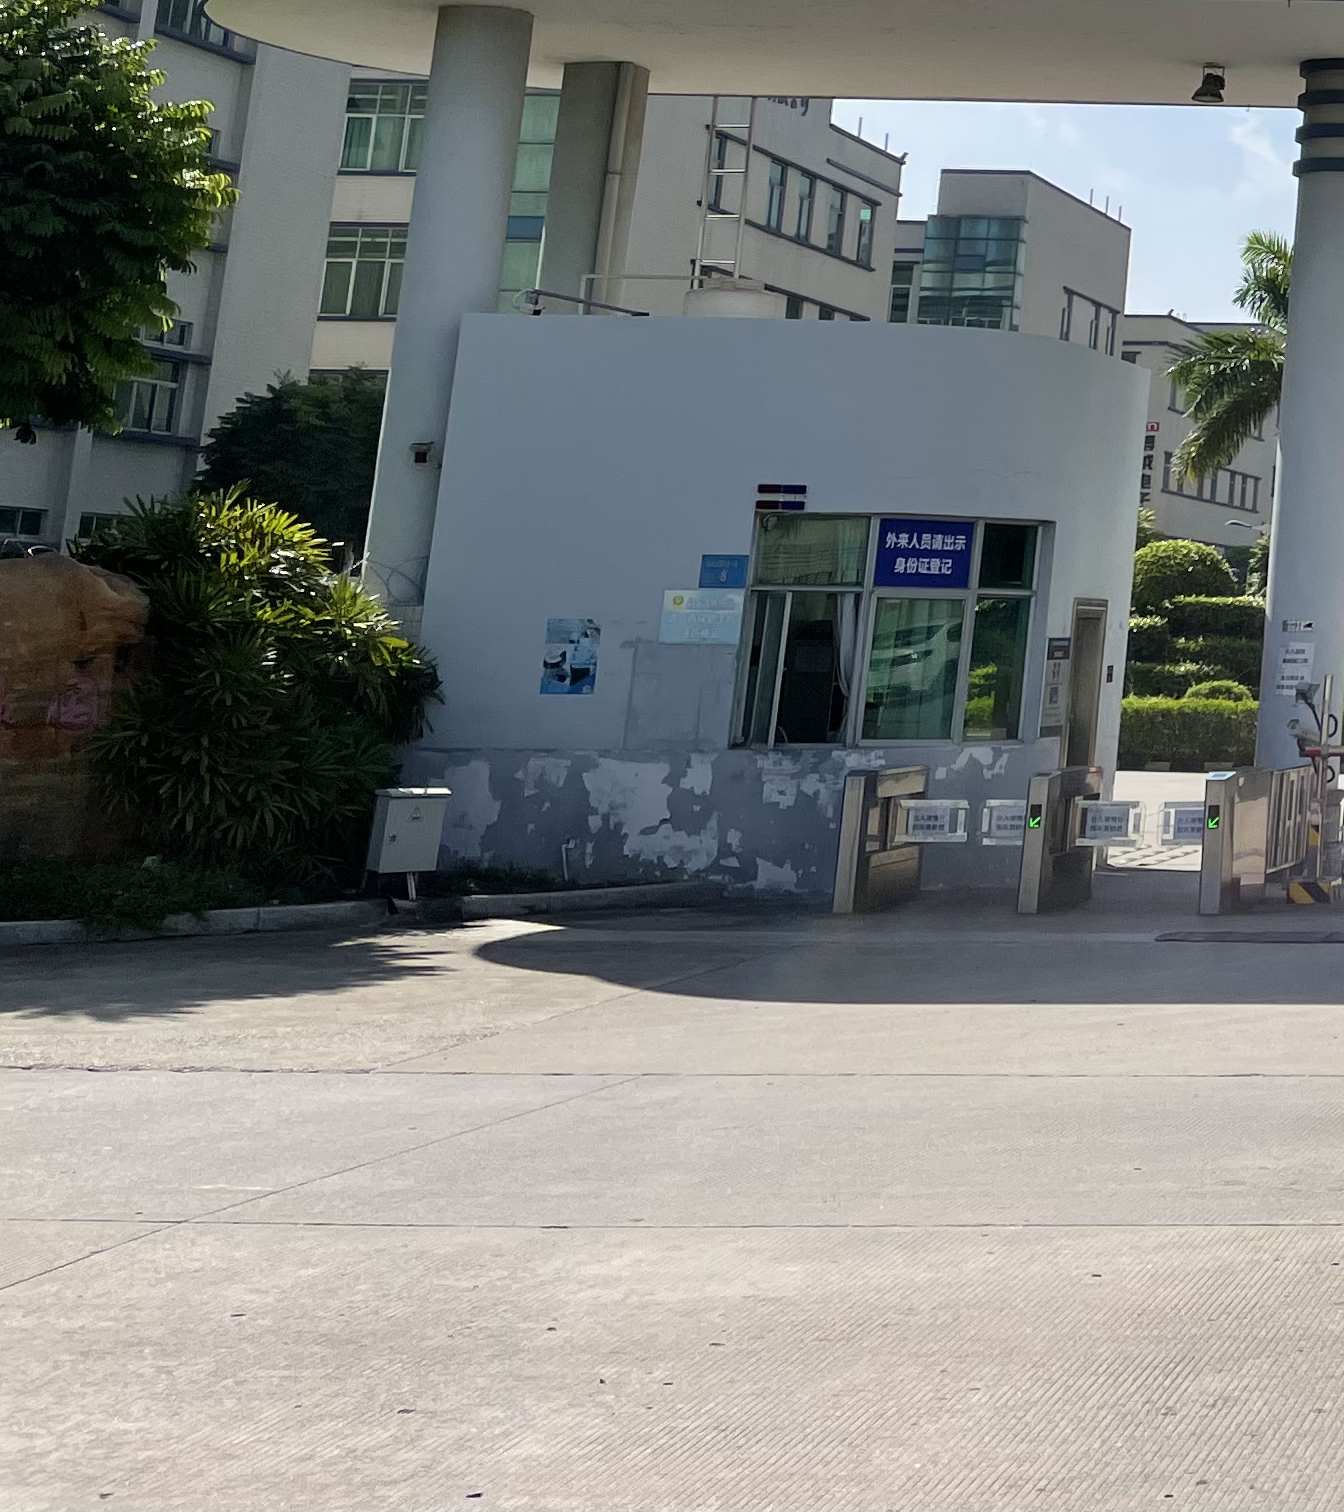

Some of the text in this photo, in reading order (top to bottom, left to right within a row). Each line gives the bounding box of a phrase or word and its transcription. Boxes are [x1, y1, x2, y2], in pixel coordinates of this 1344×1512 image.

[885, 532, 967, 550] 外来人员请出示
[894, 557, 953, 575] 身份证登记
